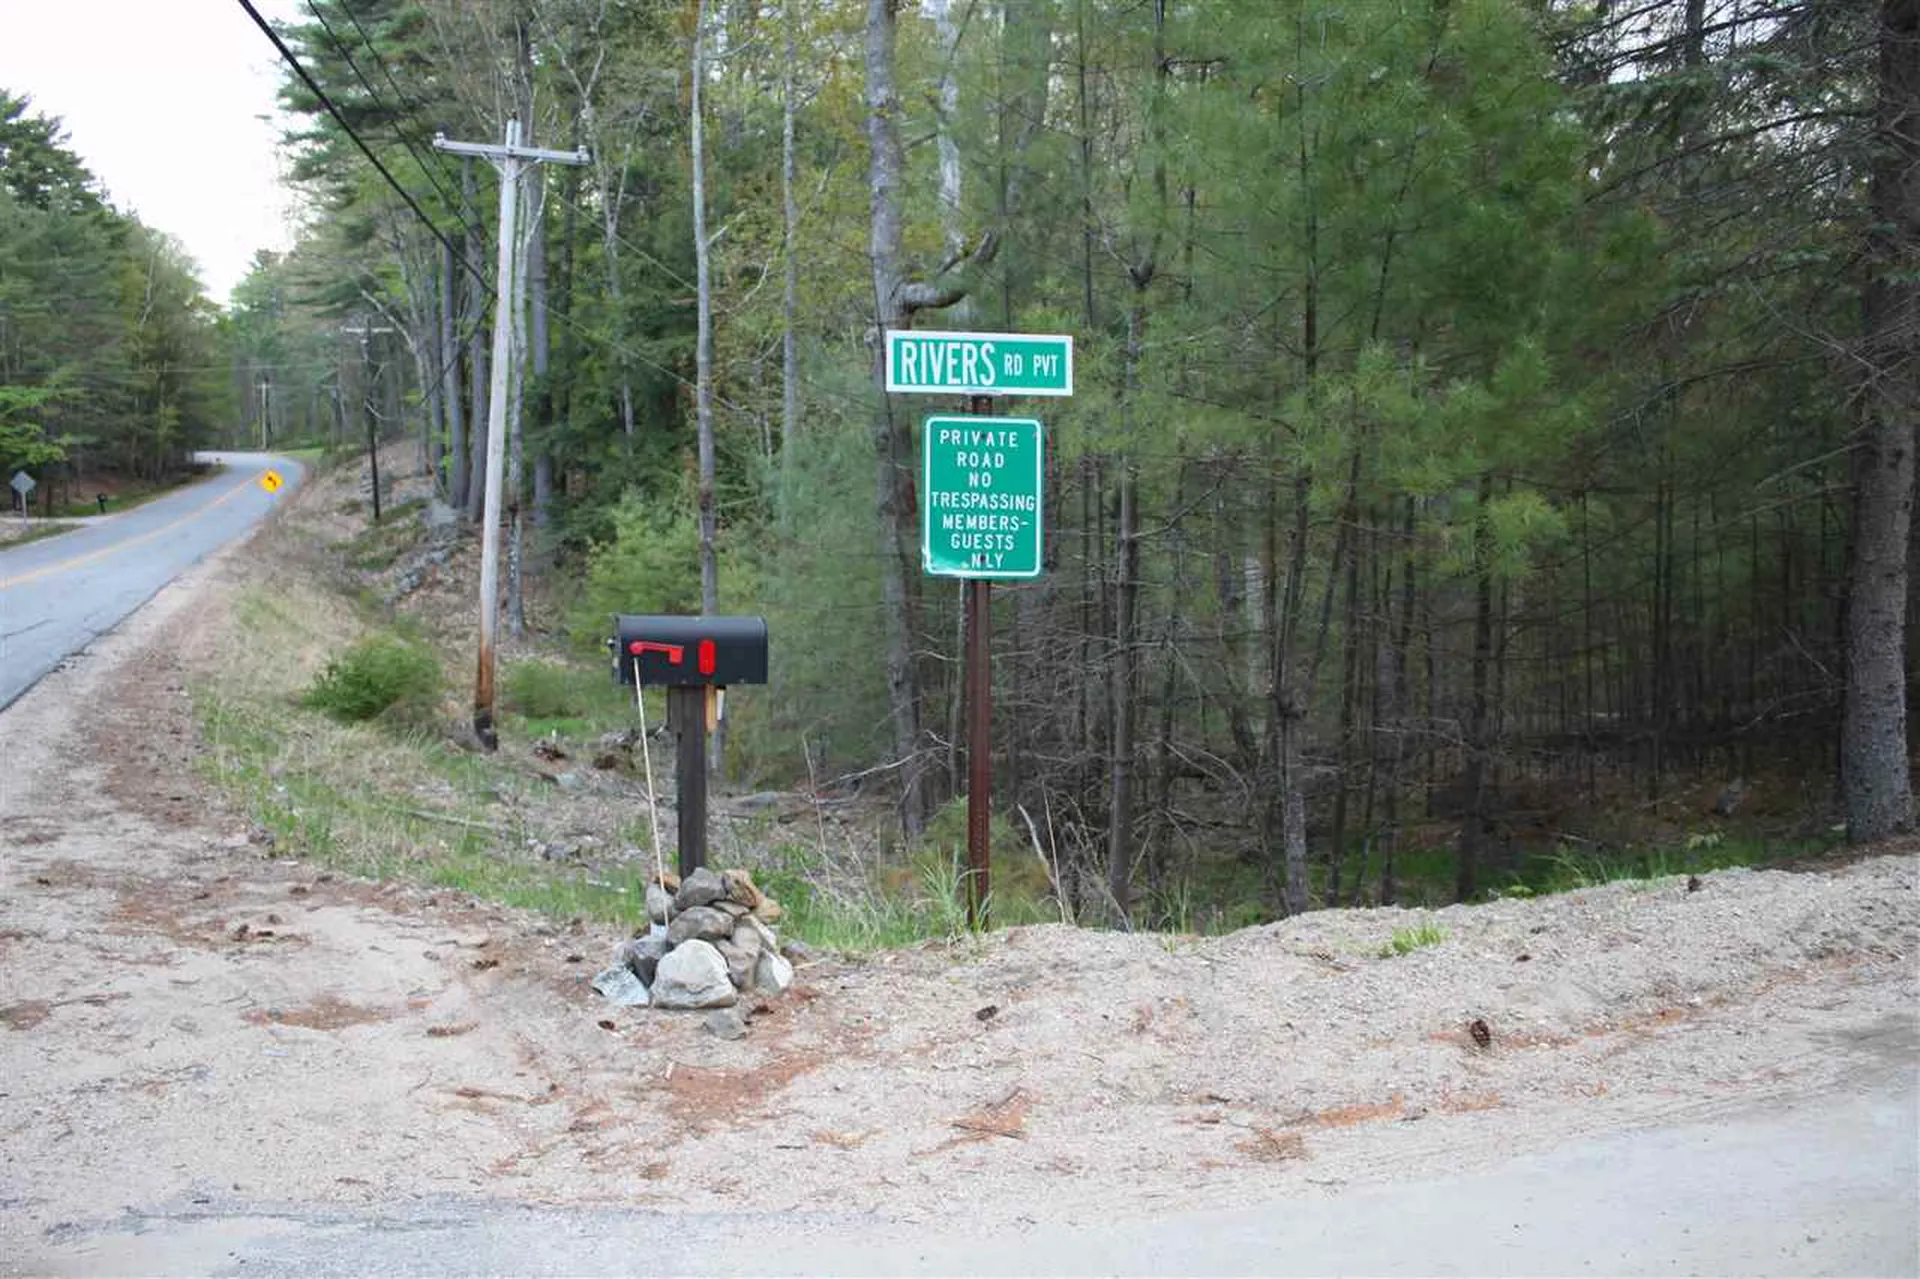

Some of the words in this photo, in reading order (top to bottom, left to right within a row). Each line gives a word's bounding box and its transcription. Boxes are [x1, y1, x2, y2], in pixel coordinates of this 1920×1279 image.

[901, 341, 996, 386] RIVERS
[1004, 353, 1022, 376] RD
[1033, 354, 1058, 377] PVT
[940, 429, 1019, 447] PRIVATE
[957, 452, 1004, 468] ROAD
[969, 472, 992, 486] NO
[932, 491, 1035, 511] TRESPASSING
[942, 514, 1030, 531] MEMBERS-
[951, 534, 1015, 550] GUESTS
[962, 553, 1004, 568] NLY
